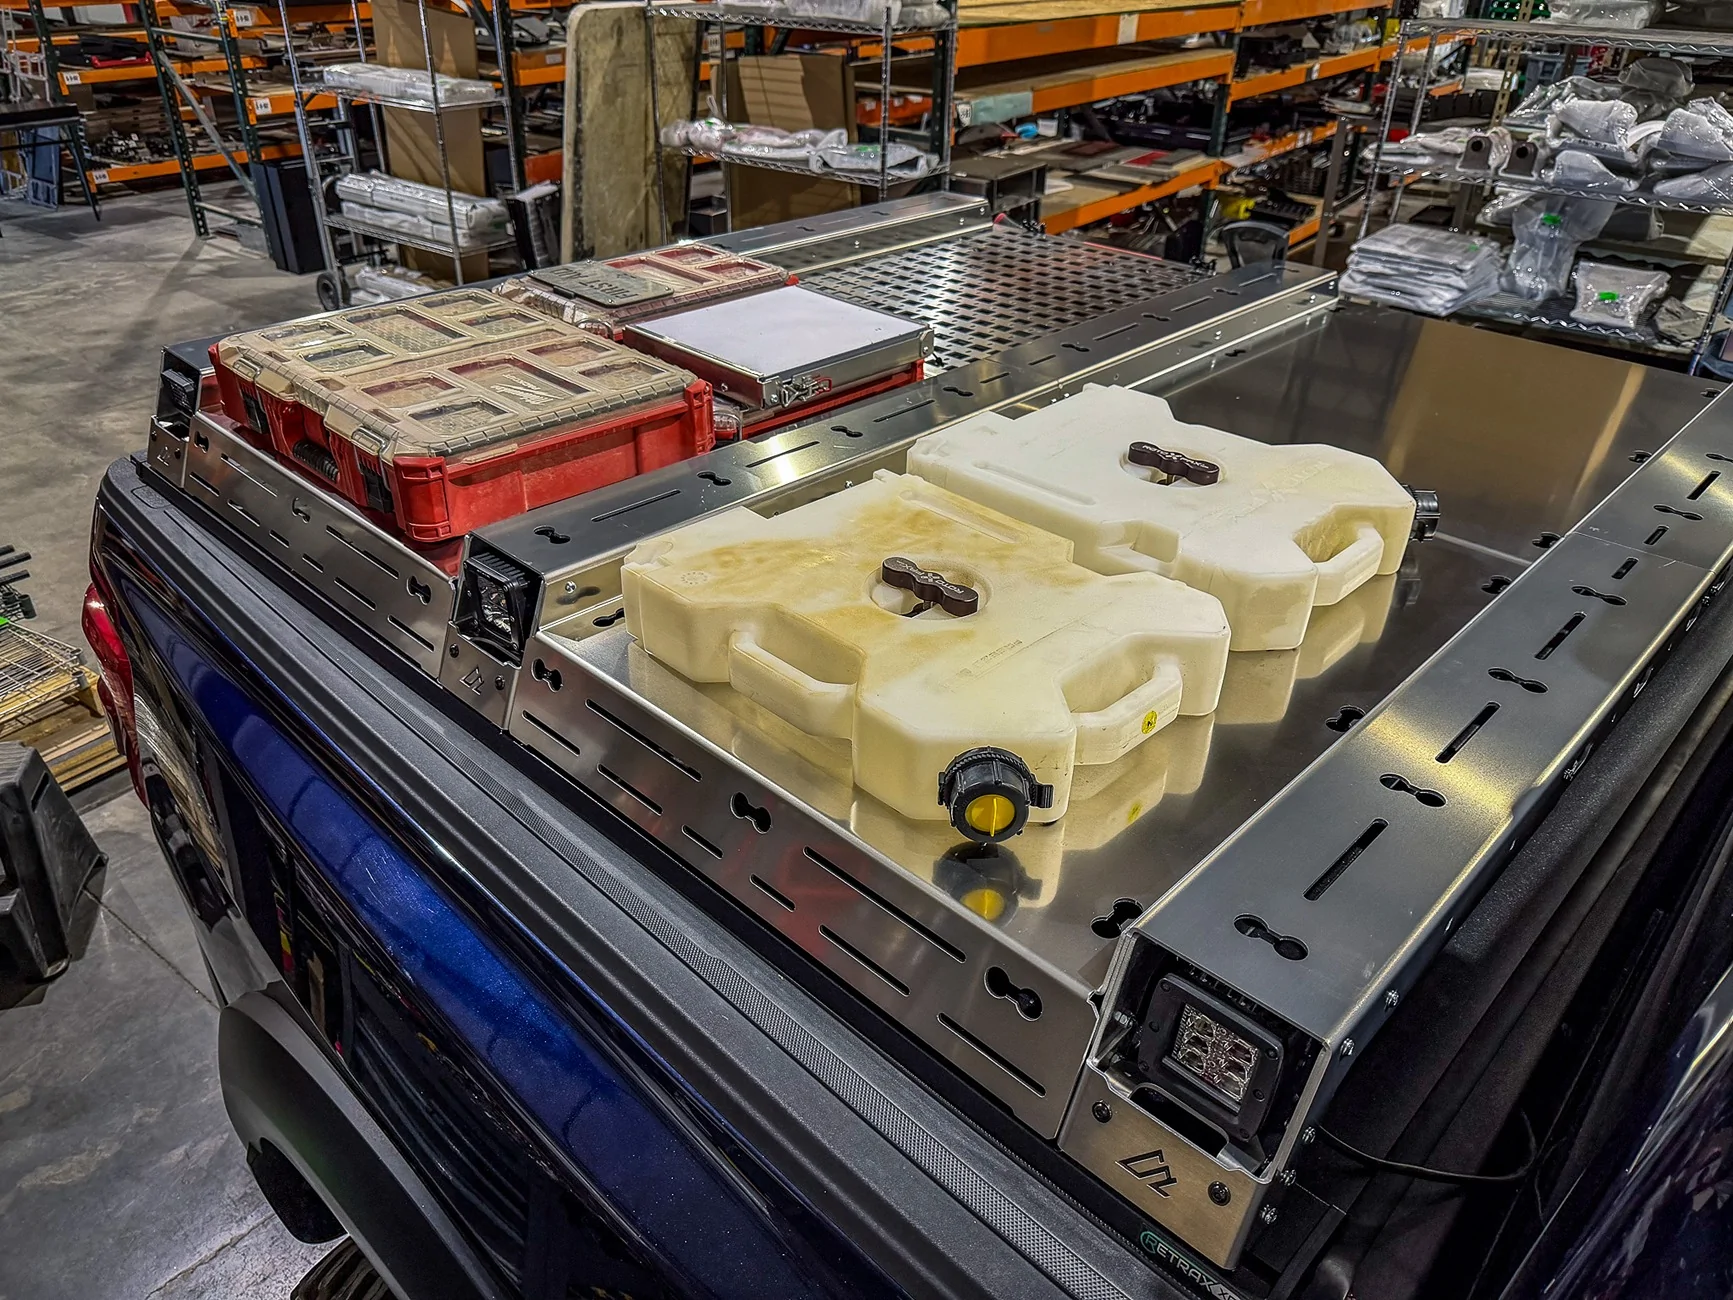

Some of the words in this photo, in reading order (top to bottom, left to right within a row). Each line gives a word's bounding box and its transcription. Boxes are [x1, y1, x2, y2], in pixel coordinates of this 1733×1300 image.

[549, 267, 590, 280] AID
[580, 279, 638, 300] FIRST
[935, 579, 965, 595] ROTO
